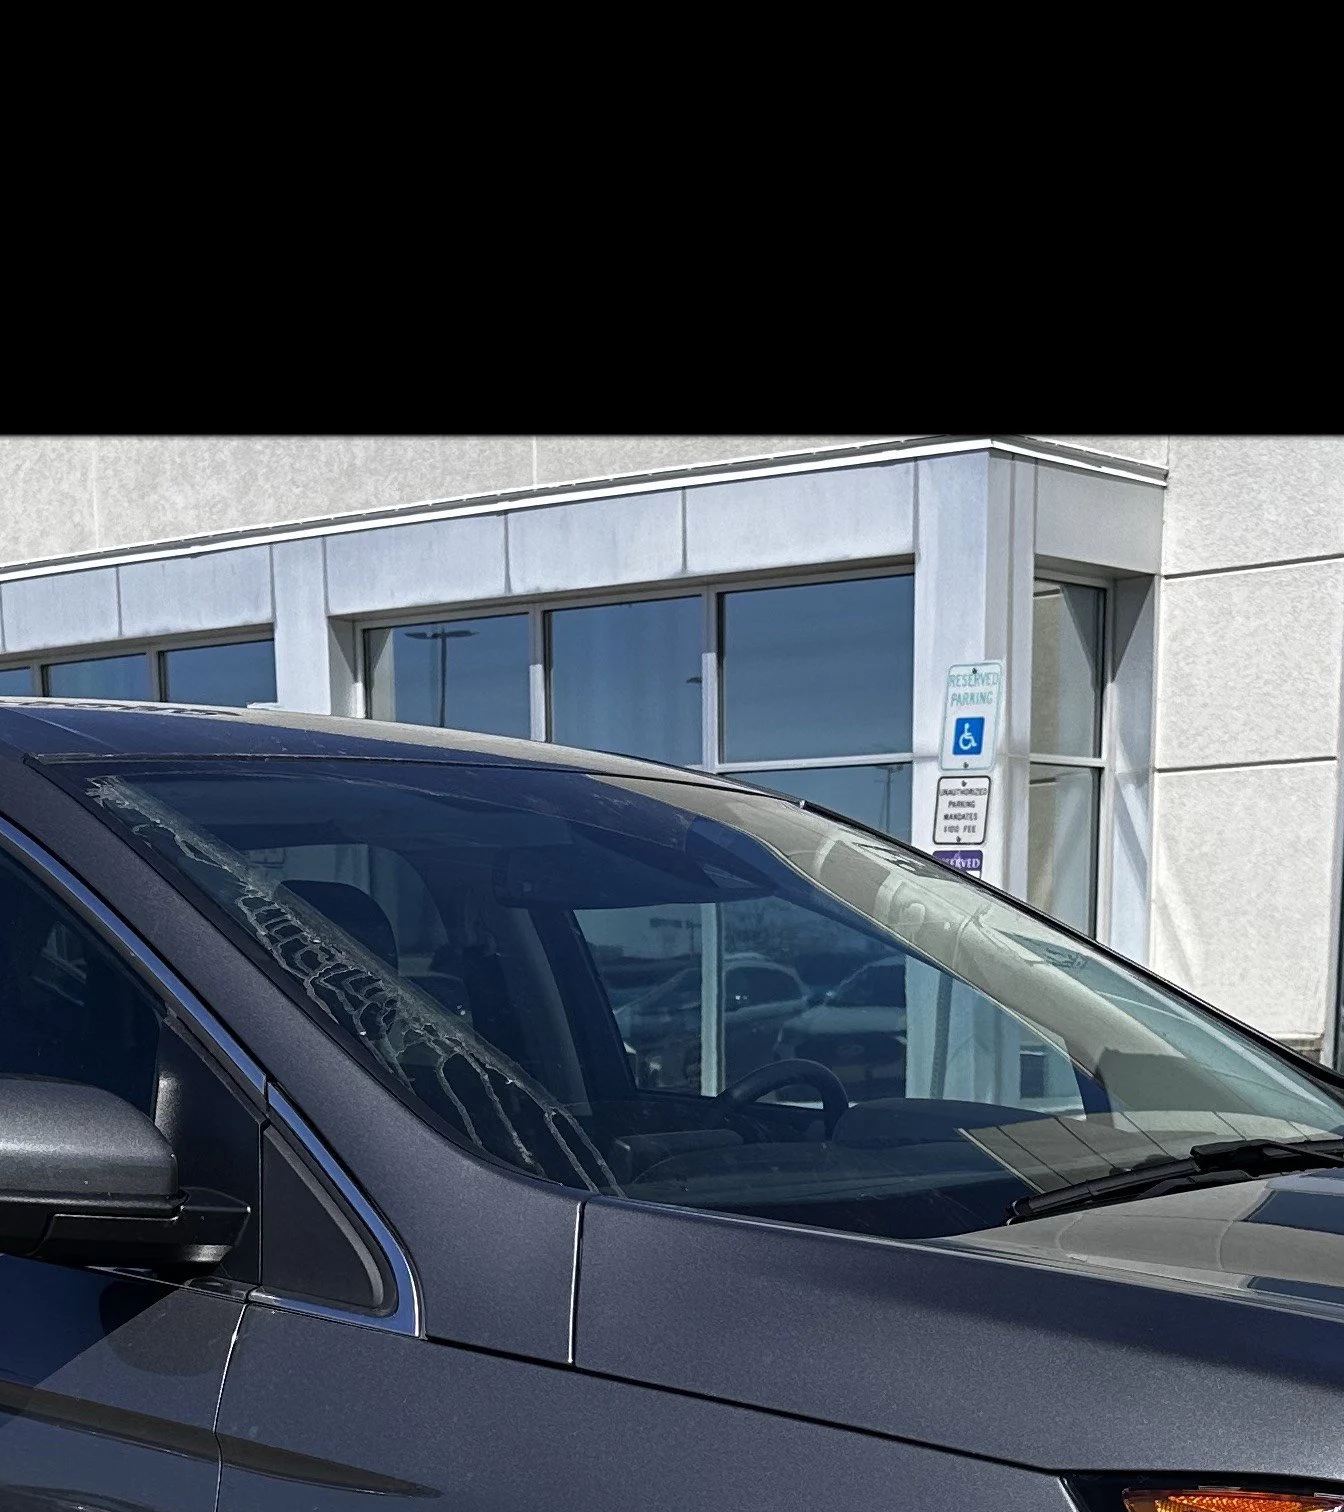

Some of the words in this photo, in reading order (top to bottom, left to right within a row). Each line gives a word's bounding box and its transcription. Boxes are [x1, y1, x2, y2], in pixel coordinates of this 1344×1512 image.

[948, 672, 1000, 687] RESERVED
[951, 691, 993, 706] PARKING
[939, 788, 988, 796] UNAUTHORIZED
